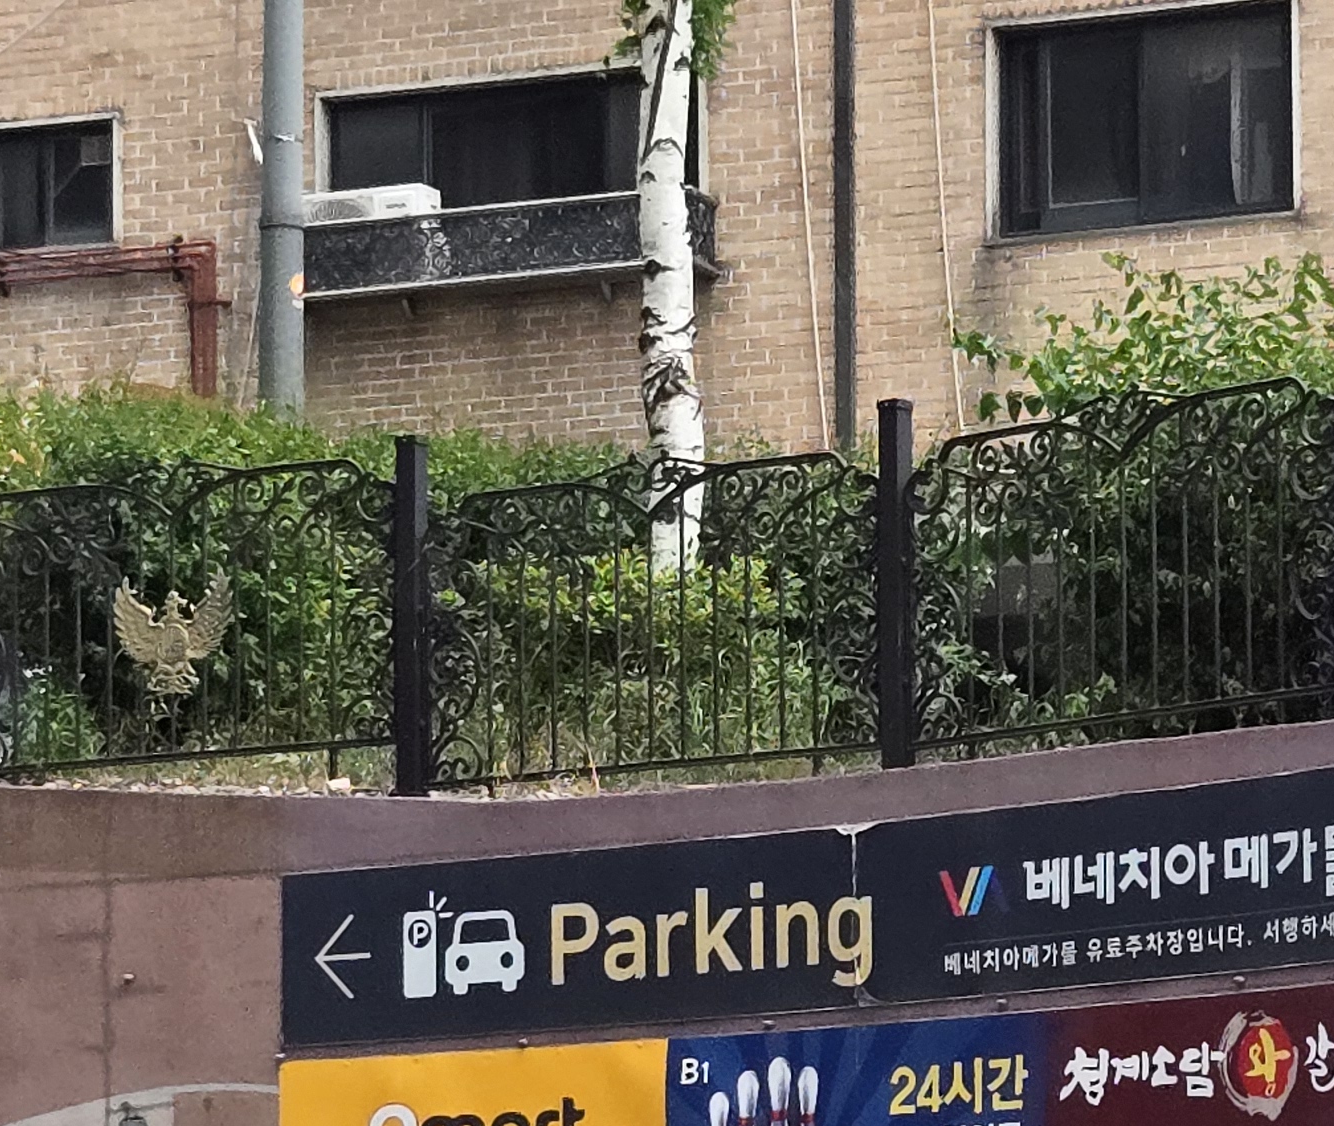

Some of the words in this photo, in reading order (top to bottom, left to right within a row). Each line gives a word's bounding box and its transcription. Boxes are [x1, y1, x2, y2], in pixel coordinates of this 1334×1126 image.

[550, 881, 873, 988] Parking
[679, 1057, 710, 1085] B1
[889, 1053, 1029, 1116] 24시간
